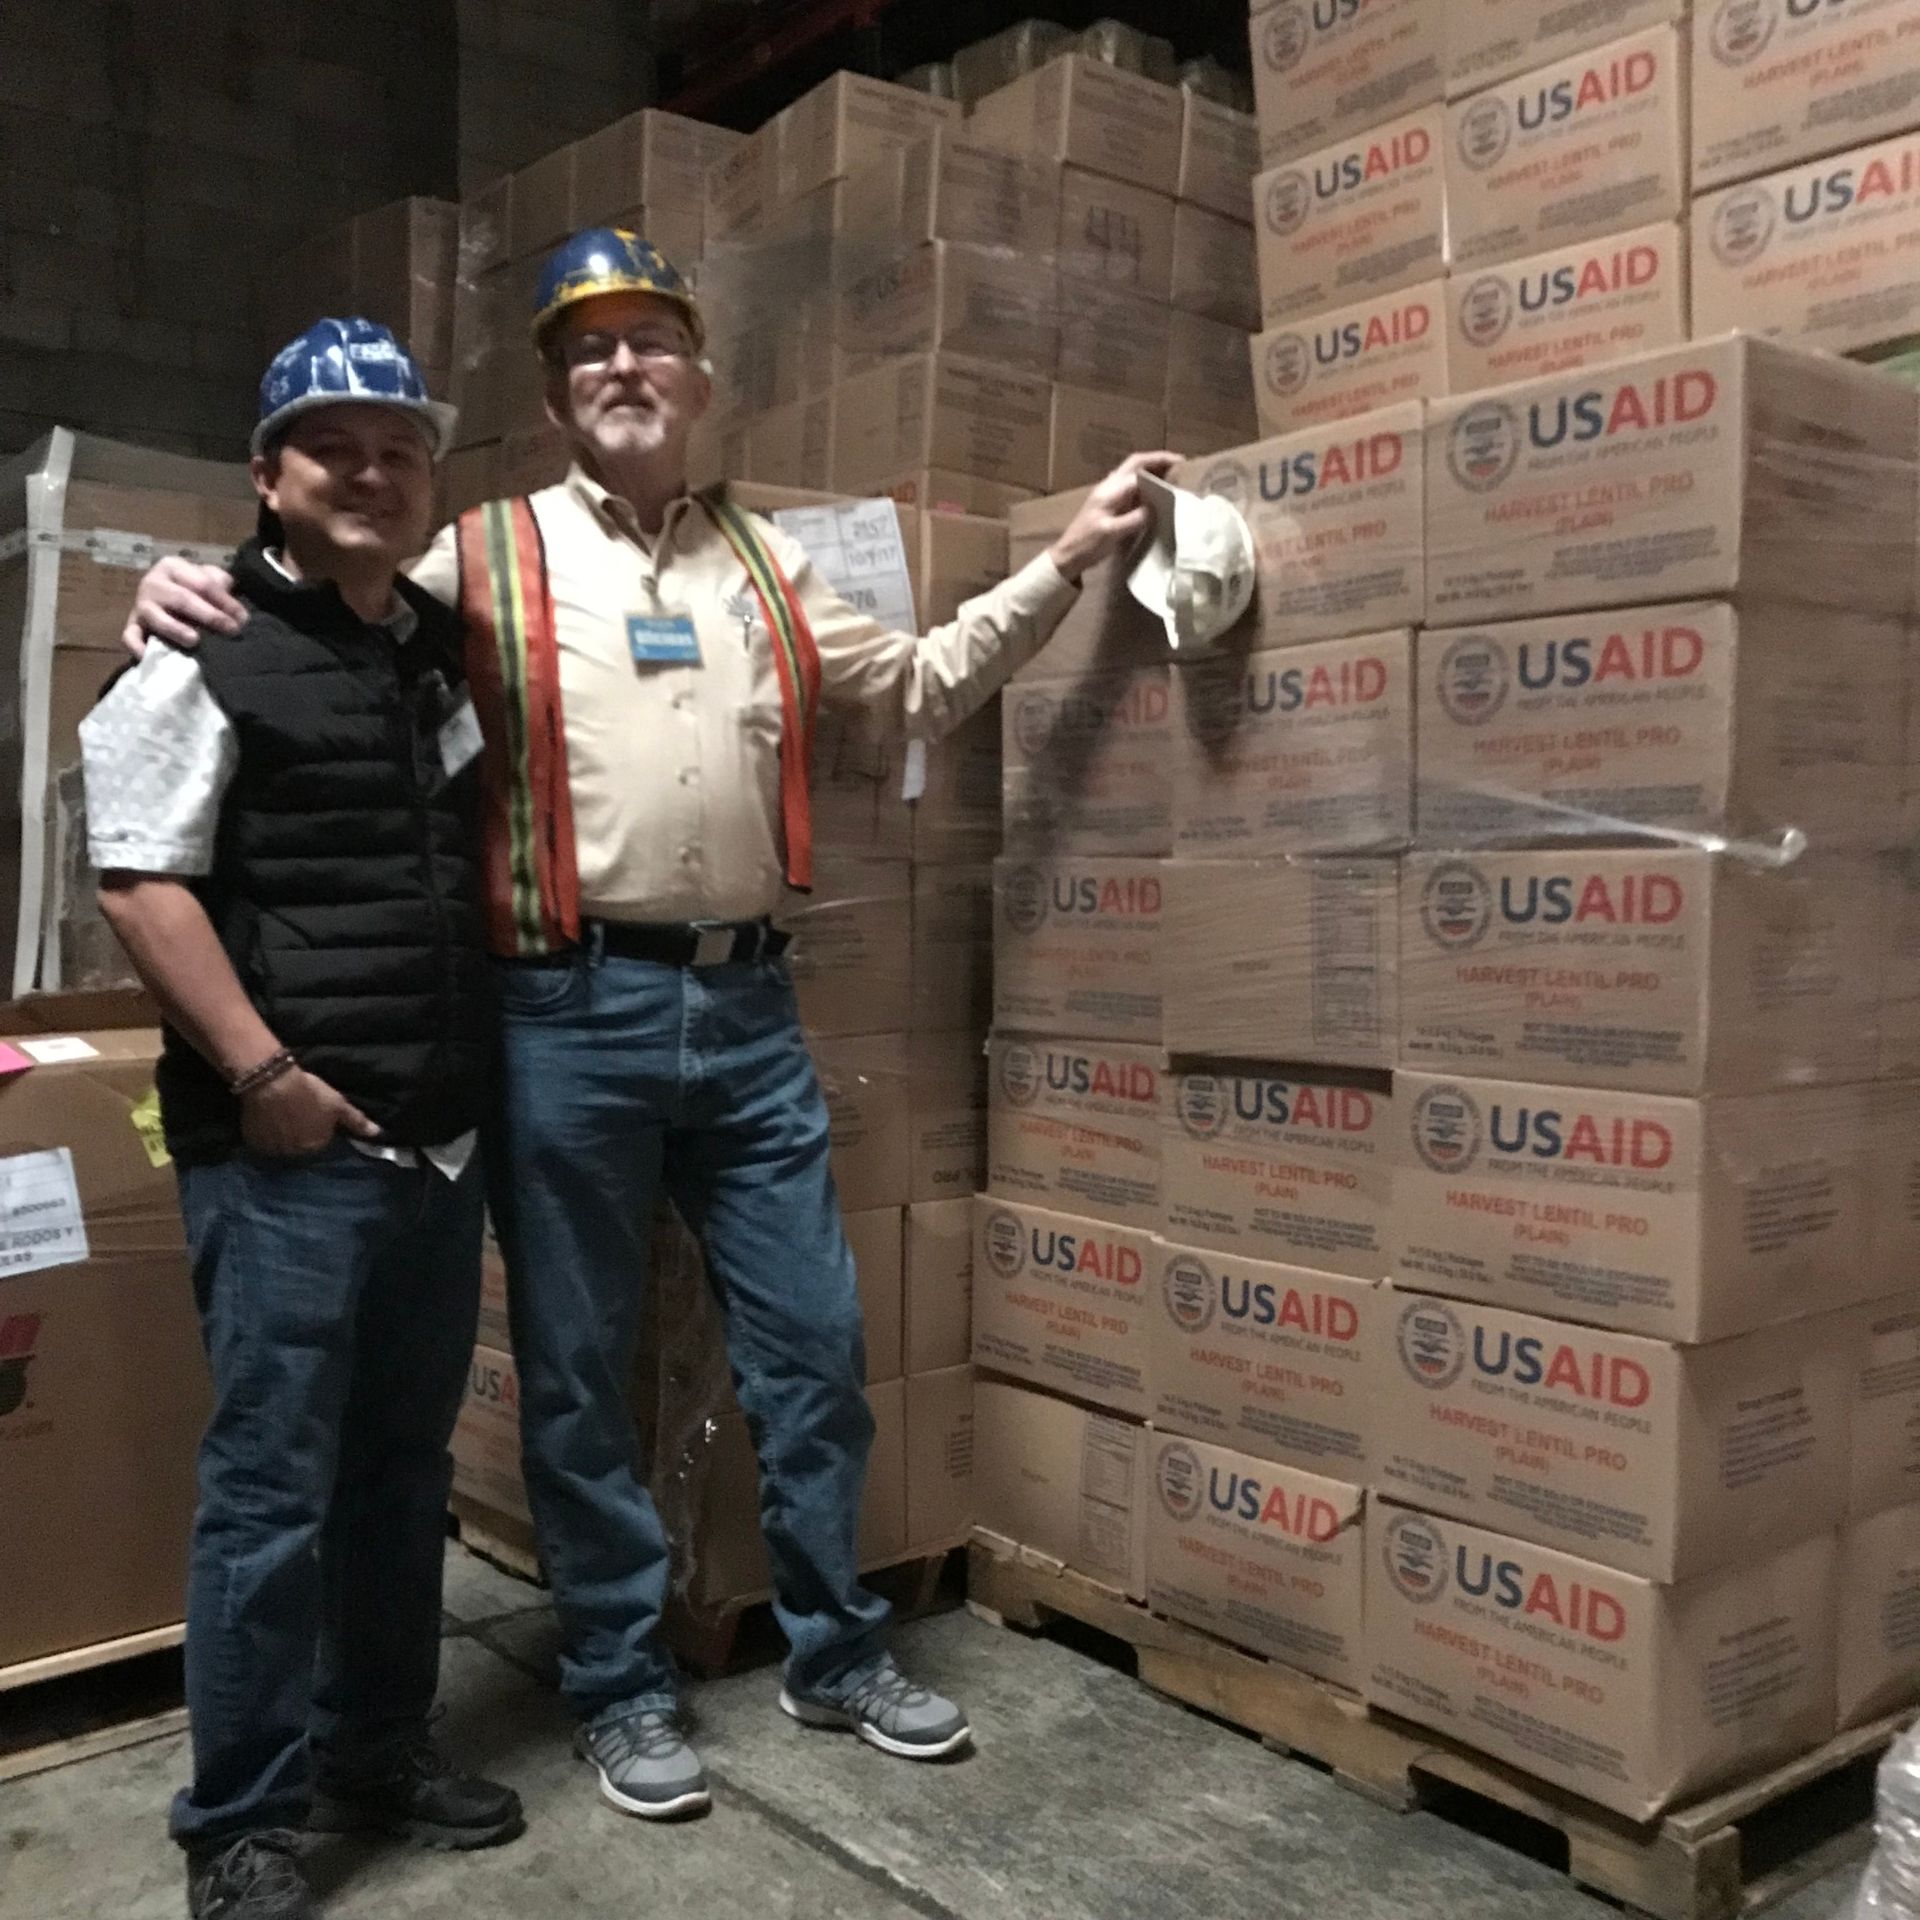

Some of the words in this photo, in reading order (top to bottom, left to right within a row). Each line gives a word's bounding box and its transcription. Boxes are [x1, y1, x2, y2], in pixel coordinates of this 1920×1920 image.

[1313, 0, 1360, 30] US
[1517, 53, 1656, 131] USAID
[1314, 130, 1429, 199] USAID
[1784, 150, 1920, 224] USAI
[1519, 248, 1658, 312] USAID
[1314, 305, 1428, 365] USAID
[1529, 371, 1716, 450] USAID
[1259, 432, 1402, 501] USAID
[1247, 655, 1388, 715] USAID
[1518, 628, 1703, 691] USAID
[1052, 876, 1162, 914] USAID
[1500, 876, 1683, 925] USAID
[1046, 1053, 1155, 1102] USAID
[1234, 1081, 1372, 1131] USAID
[1491, 1105, 1672, 1171] USAID
[1203, 1155, 1264, 1177] HARVEST
[1270, 1164, 1320, 1185] LENTIL
[1324, 1171, 1357, 1190] PRO
[1444, 1190, 1526, 1216] HARVEST
[1534, 1202, 1596, 1230] LENTIL
[1606, 1213, 1649, 1235] PRO
[1032, 1228, 1142, 1285] USAID
[1004, 1291, 1054, 1314] HARVEST
[1059, 1304, 1096, 1328] LENTIL
[1102, 1316, 1128, 1334] PRO
[1221, 1276, 1358, 1341] USAID
[472, 1361, 517, 1409] USA
[1189, 1346, 1251, 1373] HARVEST
[1257, 1362, 1304, 1389] LENTIL
[1311, 1376, 1343, 1396] PRO
[1474, 1326, 1650, 1408] USAID
[1429, 1404, 1508, 1439] HARVEST
[1516, 1426, 1576, 1460] LENTIL
[1585, 1446, 1627, 1471] PRO
[1209, 1468, 1339, 1542] USAID
[1457, 1544, 1626, 1643] USAID
[1413, 1618, 1489, 1660] HARVEST
[1496, 1649, 1554, 1689] LENTIL
[1563, 1675, 1604, 1705] PRO
